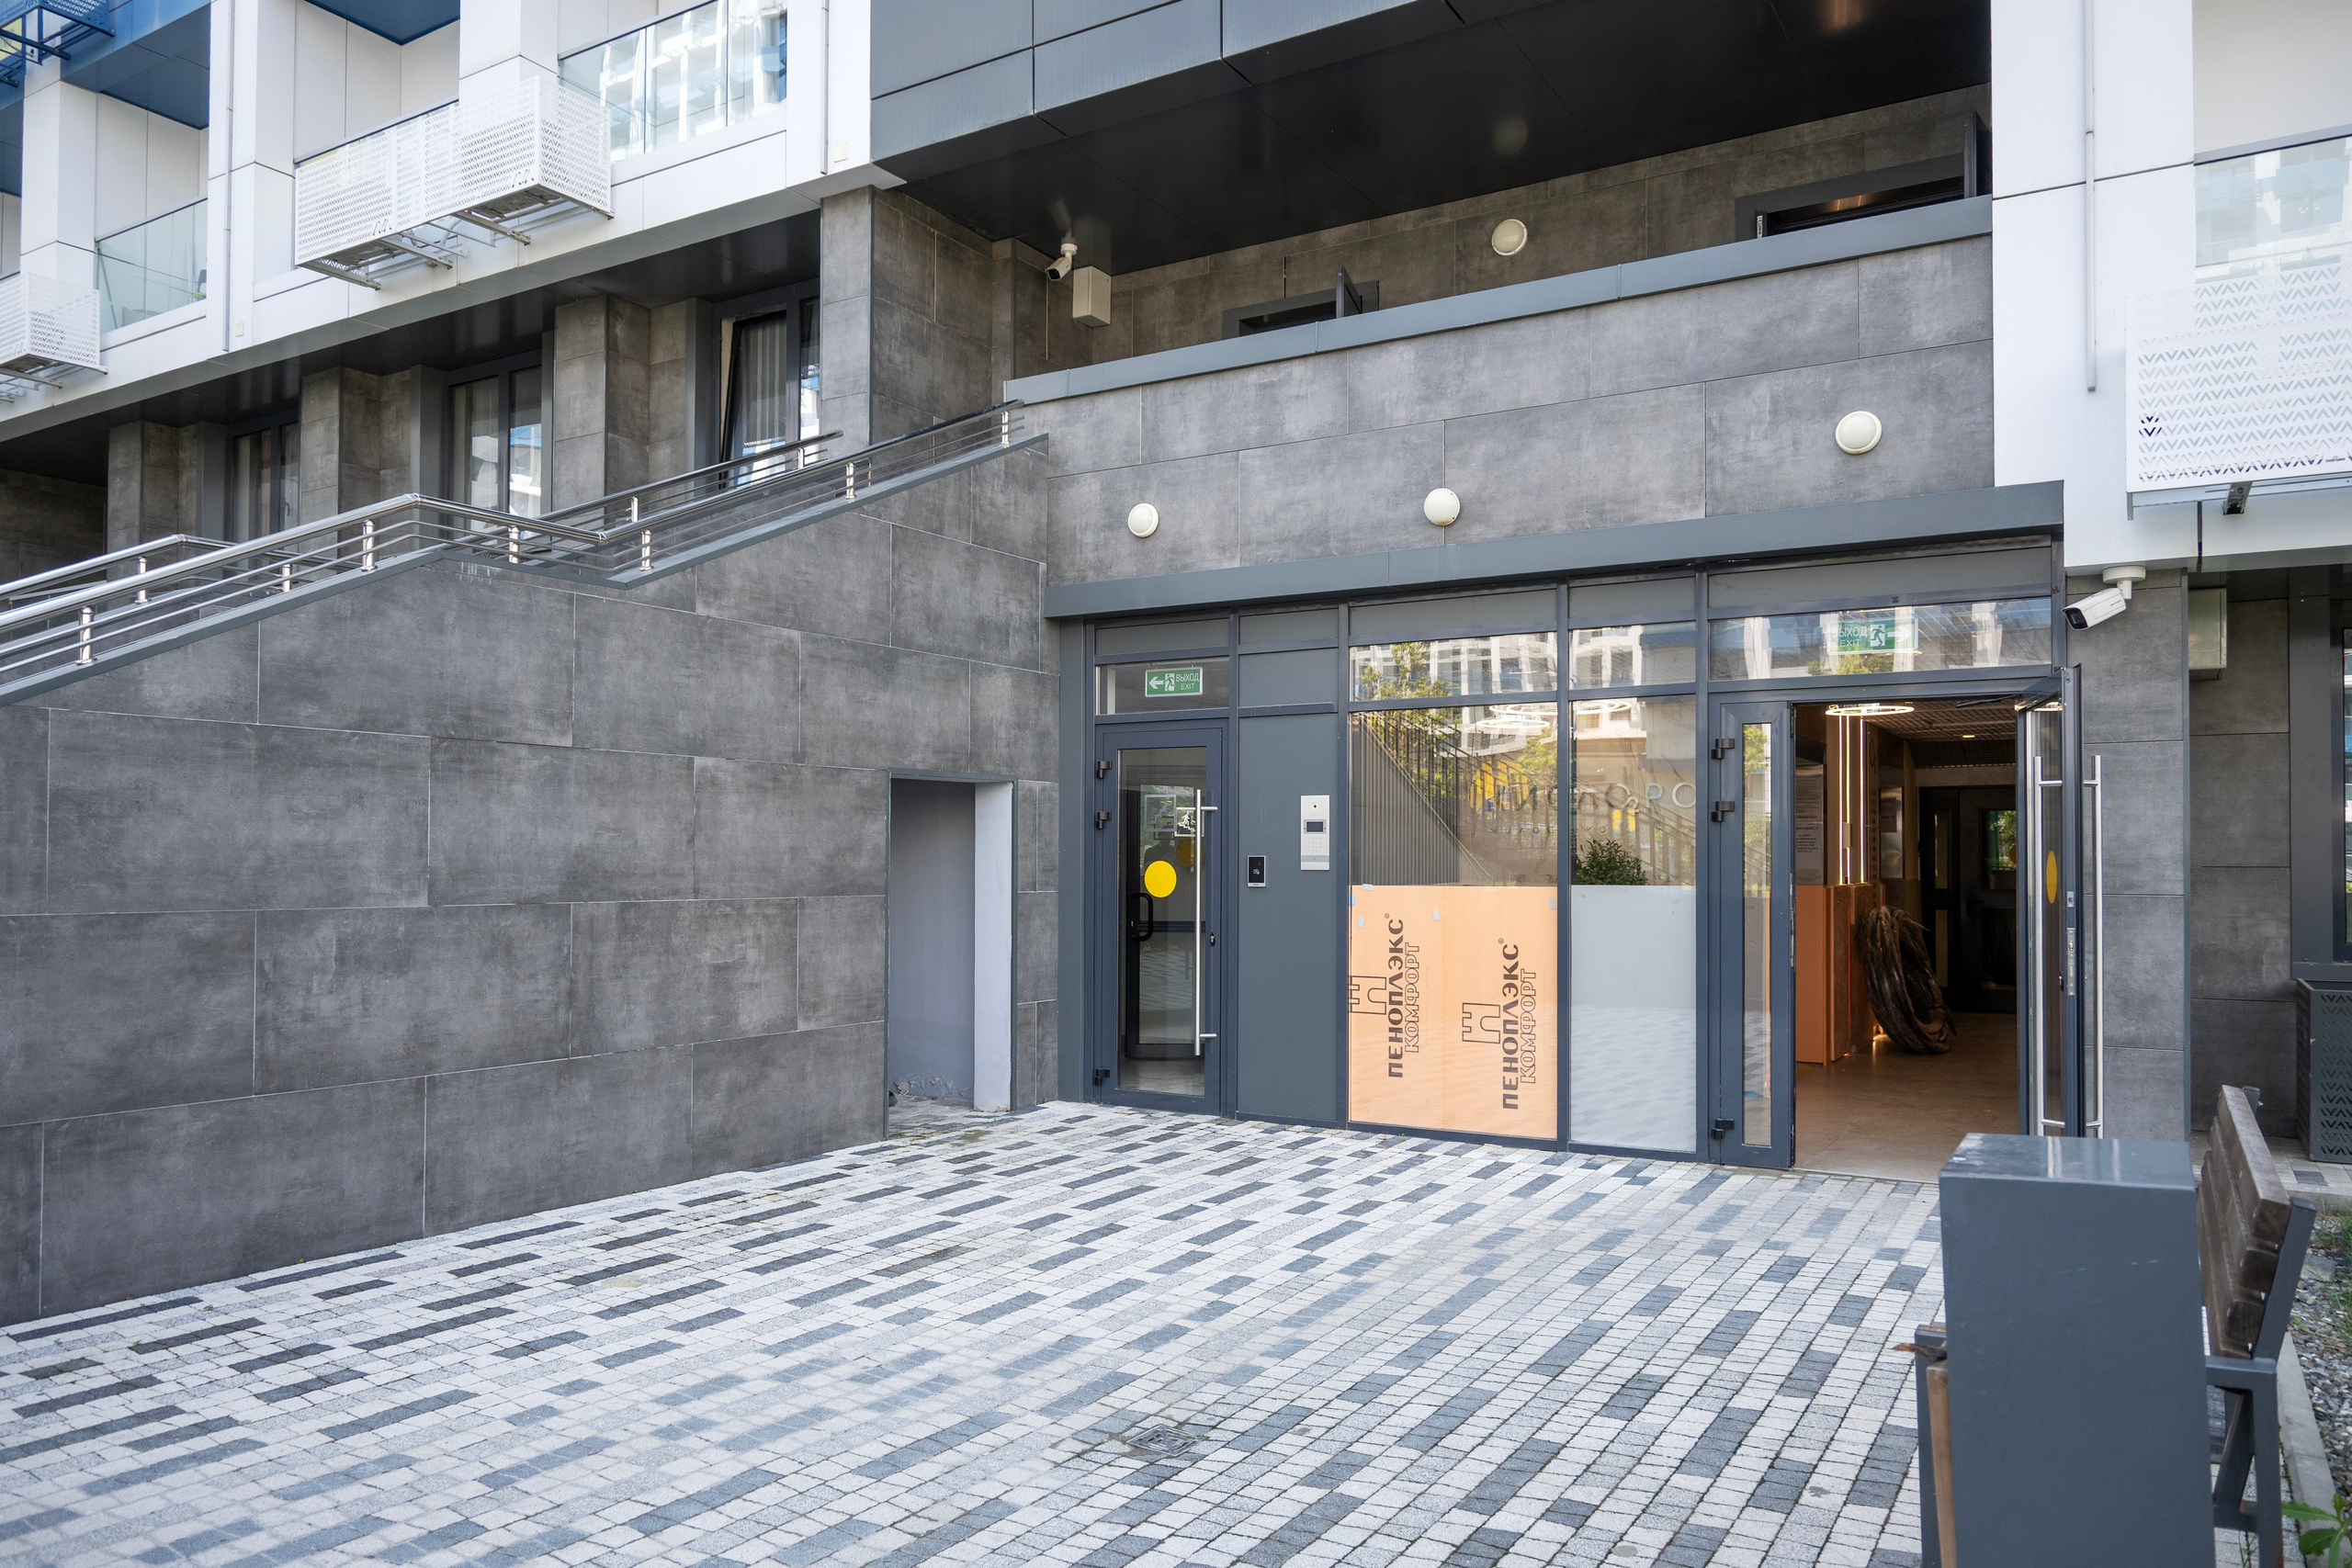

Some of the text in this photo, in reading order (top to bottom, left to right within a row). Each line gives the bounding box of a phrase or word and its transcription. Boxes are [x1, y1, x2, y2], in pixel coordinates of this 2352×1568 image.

[1832, 626, 1868, 637] ВЫХОД
[1839, 638, 1861, 648] EXIT
[1175, 672, 1200, 682] ВЫХОД
[1405, 942, 1419, 1053] КОМФОРТ
[1520, 968, 1536, 1084] КОМФОРТ
